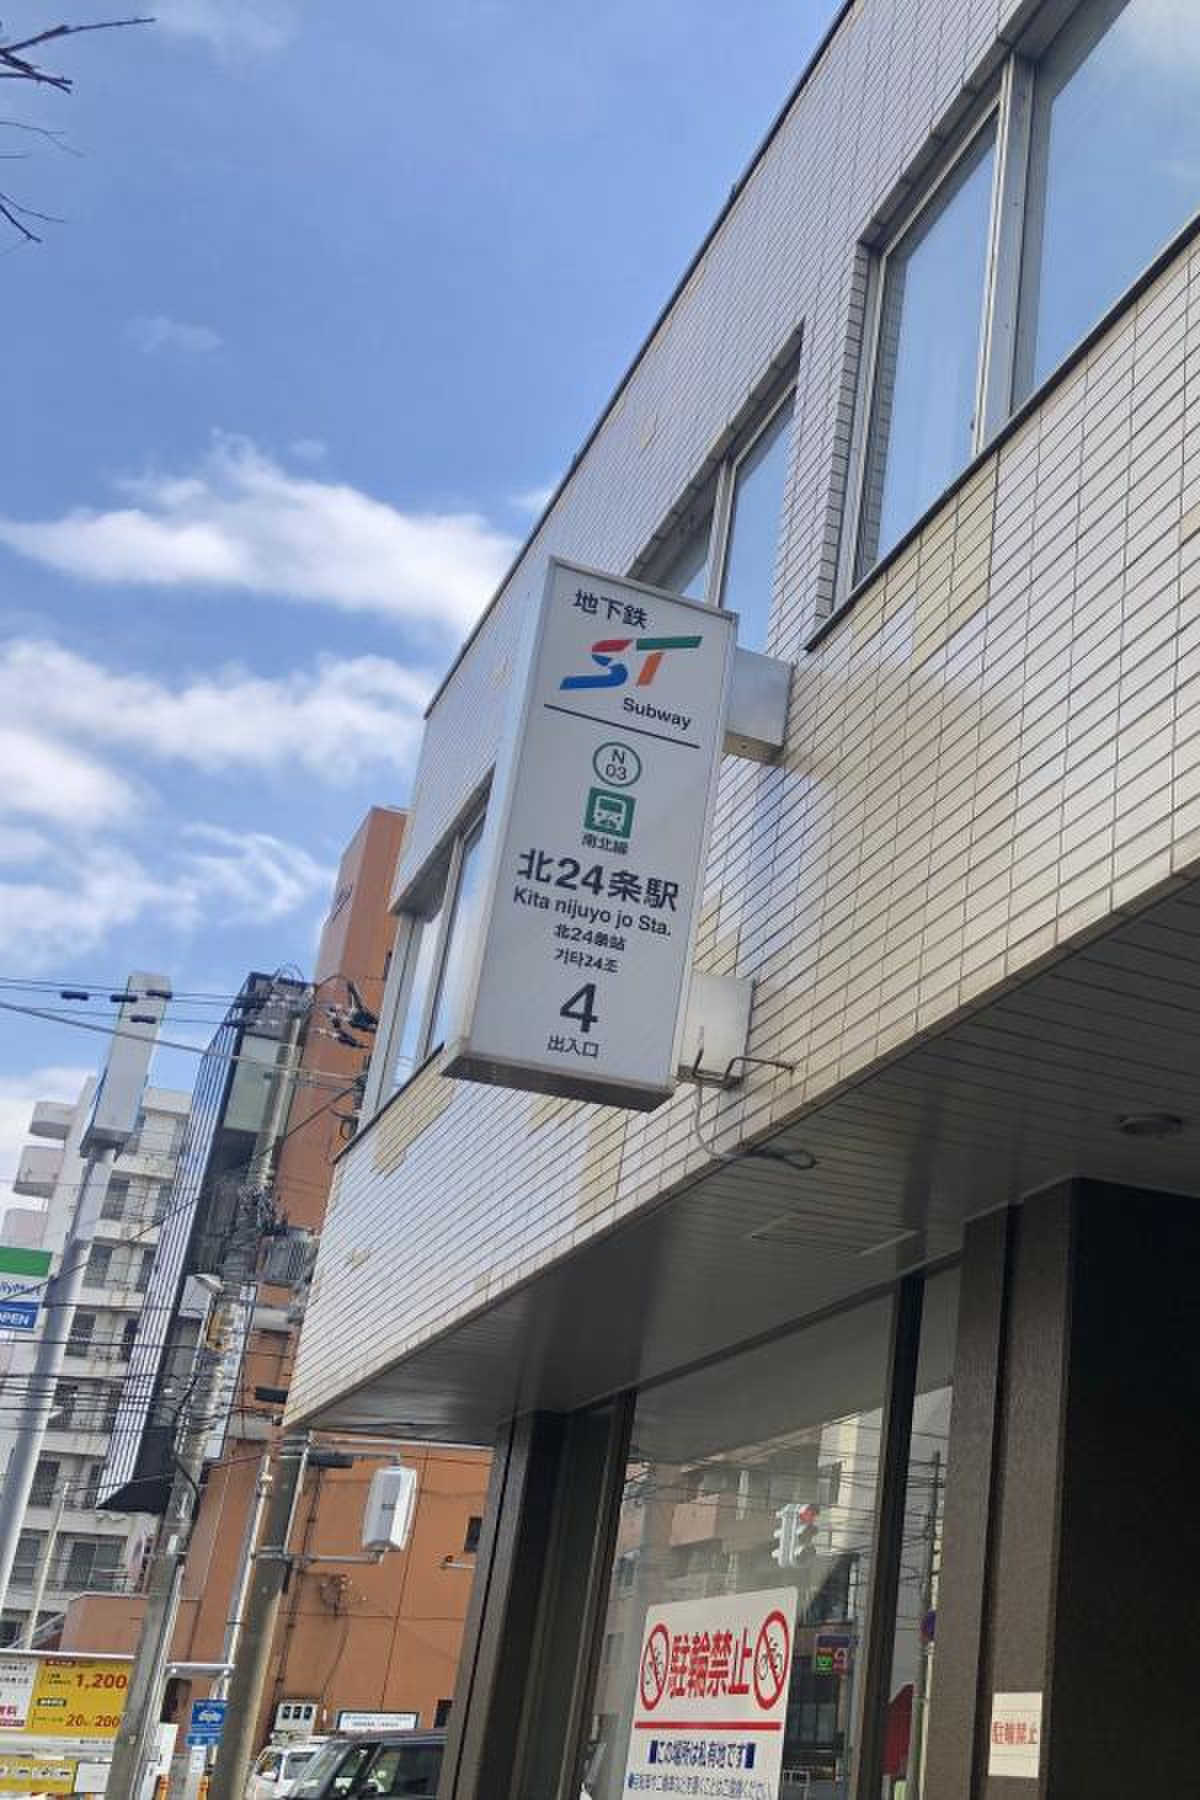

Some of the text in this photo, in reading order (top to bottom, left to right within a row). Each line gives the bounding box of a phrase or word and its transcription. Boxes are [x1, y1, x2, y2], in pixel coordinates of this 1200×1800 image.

[573, 589, 648, 629] 地下鉄
[559, 635, 703, 691] ST
[623, 697, 691, 730] Subway
[605, 763, 628, 781] 03
[611, 750, 626, 764] N
[581, 833, 629, 855] 南北線
[516, 847, 679, 912] 北24条駅
[513, 886, 671, 937] Kita nijuyo jo Sta.
[560, 983, 598, 1032] 4
[547, 1035, 599, 1059] 出入口
[0, 1310, 29, 1327] PEN
[669, 1627, 753, 1699] 駐輪禁止
